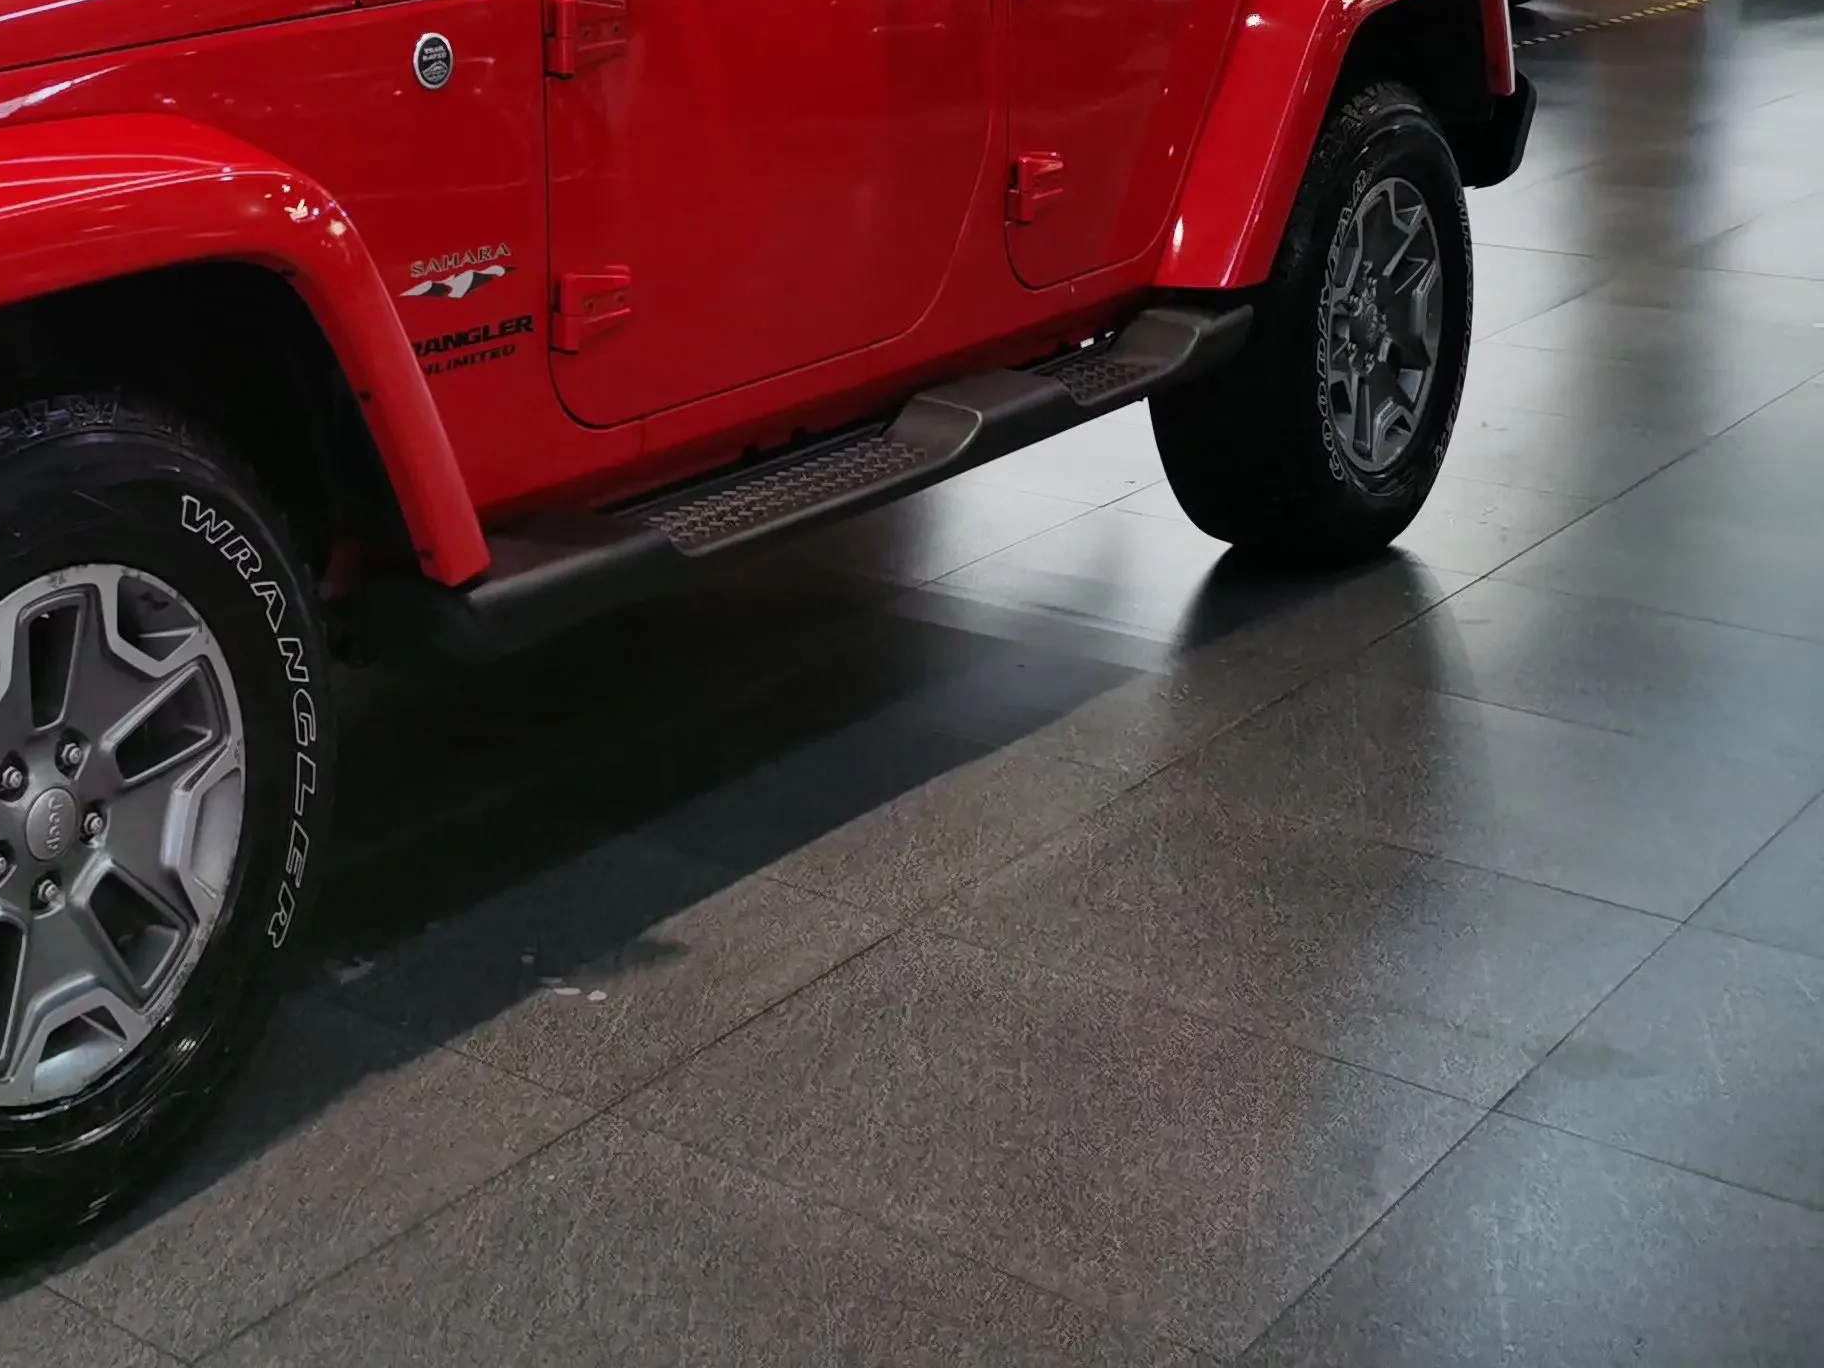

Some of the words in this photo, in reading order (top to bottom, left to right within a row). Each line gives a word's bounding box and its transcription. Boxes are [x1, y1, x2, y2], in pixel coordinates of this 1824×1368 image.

[410, 242, 511, 278] SAHARA
[411, 314, 534, 358] RANGLER
[180, 493, 318, 949] WRANGLER
